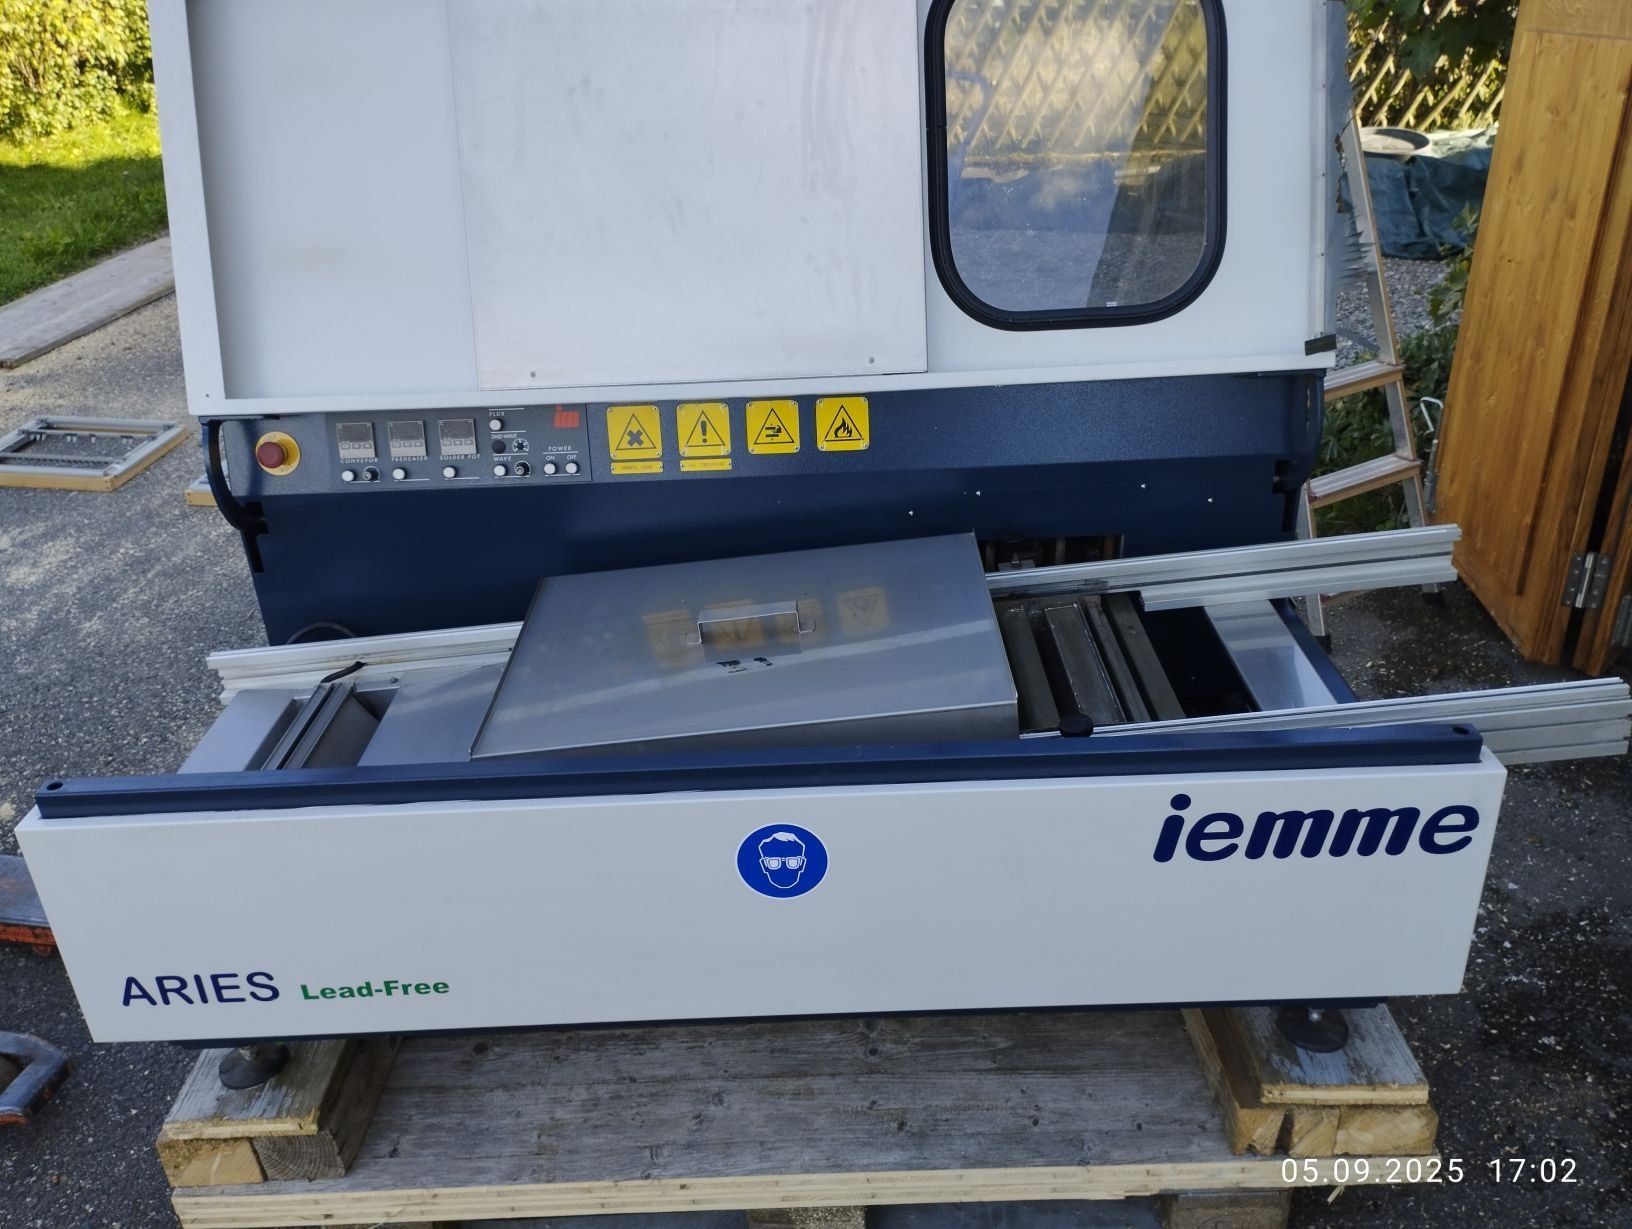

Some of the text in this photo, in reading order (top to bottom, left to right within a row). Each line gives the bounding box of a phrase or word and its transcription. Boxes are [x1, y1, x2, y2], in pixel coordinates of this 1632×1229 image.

[1153, 793, 1480, 863] iemme
[122, 971, 280, 1007] ARIES
[300, 980, 450, 1000] Lead-Free
